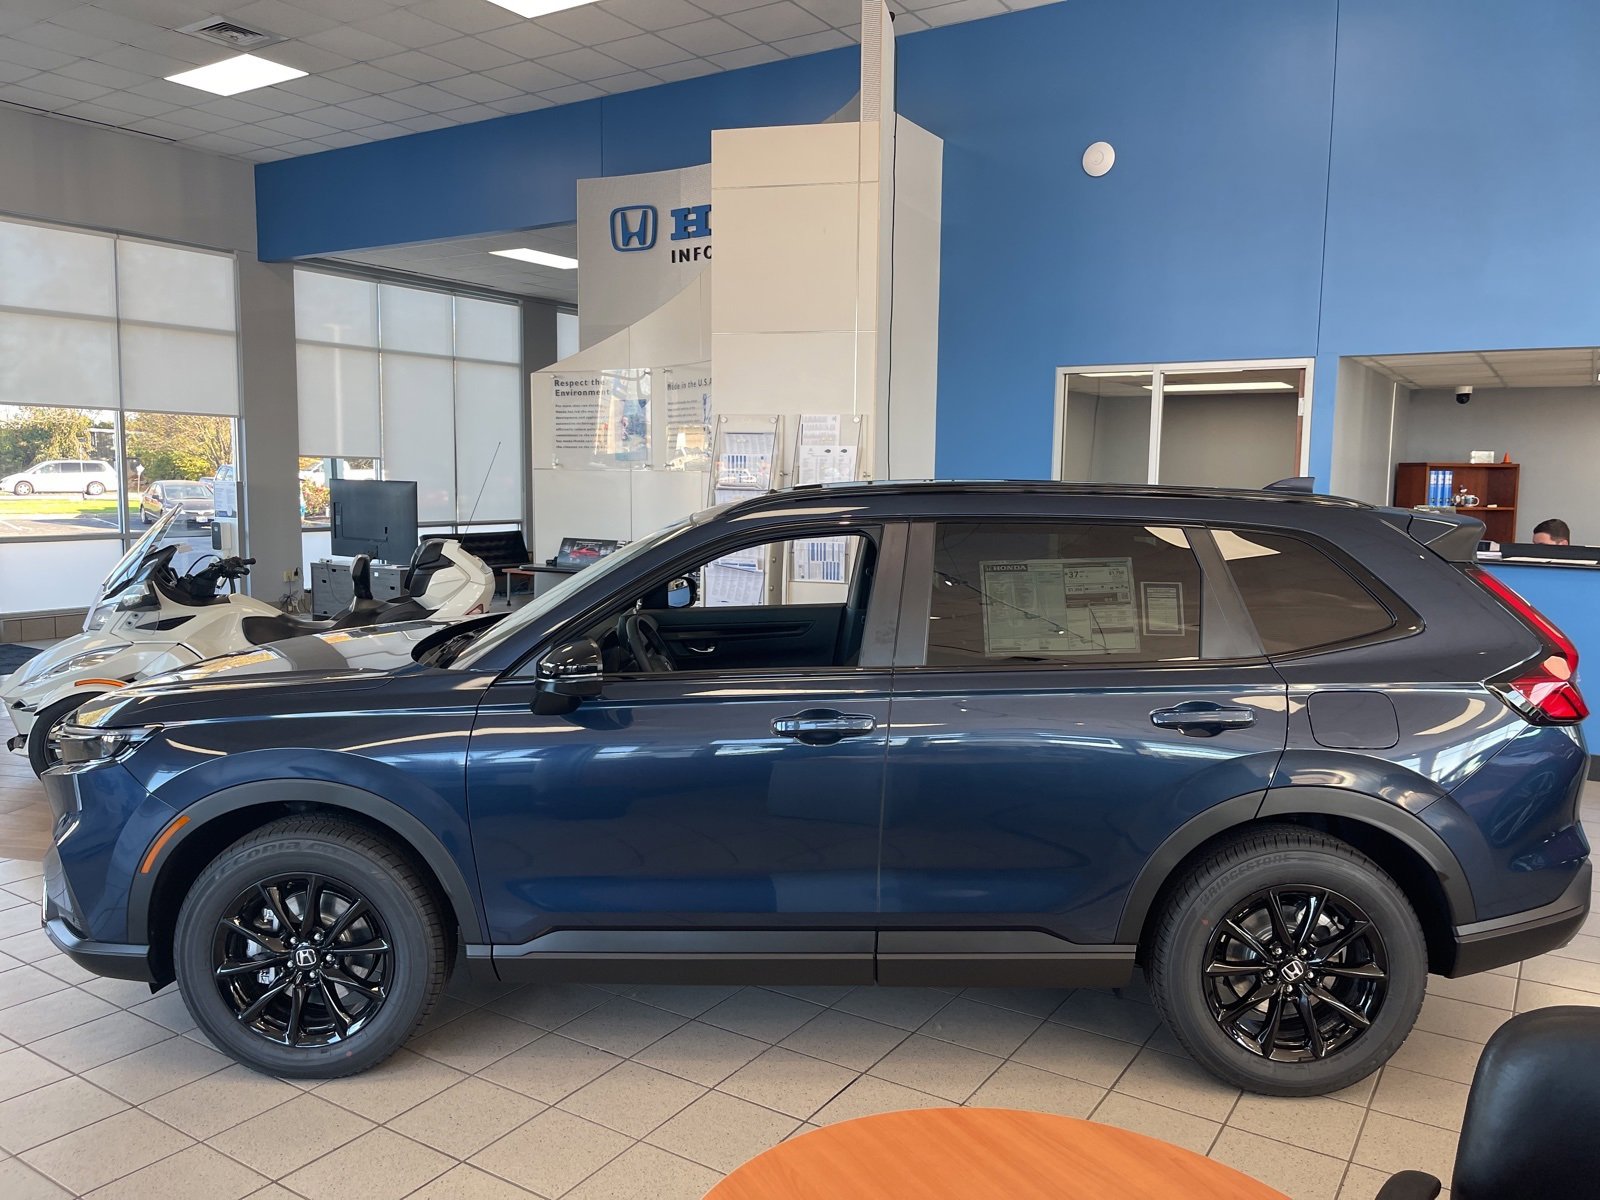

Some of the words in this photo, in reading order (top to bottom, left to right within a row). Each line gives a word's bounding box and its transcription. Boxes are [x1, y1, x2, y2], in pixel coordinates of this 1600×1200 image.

[554, 379, 588, 388] Respect
[591, 378, 605, 386] the
[555, 388, 611, 397] Environment
[1068, 571, 1079, 579] 37
